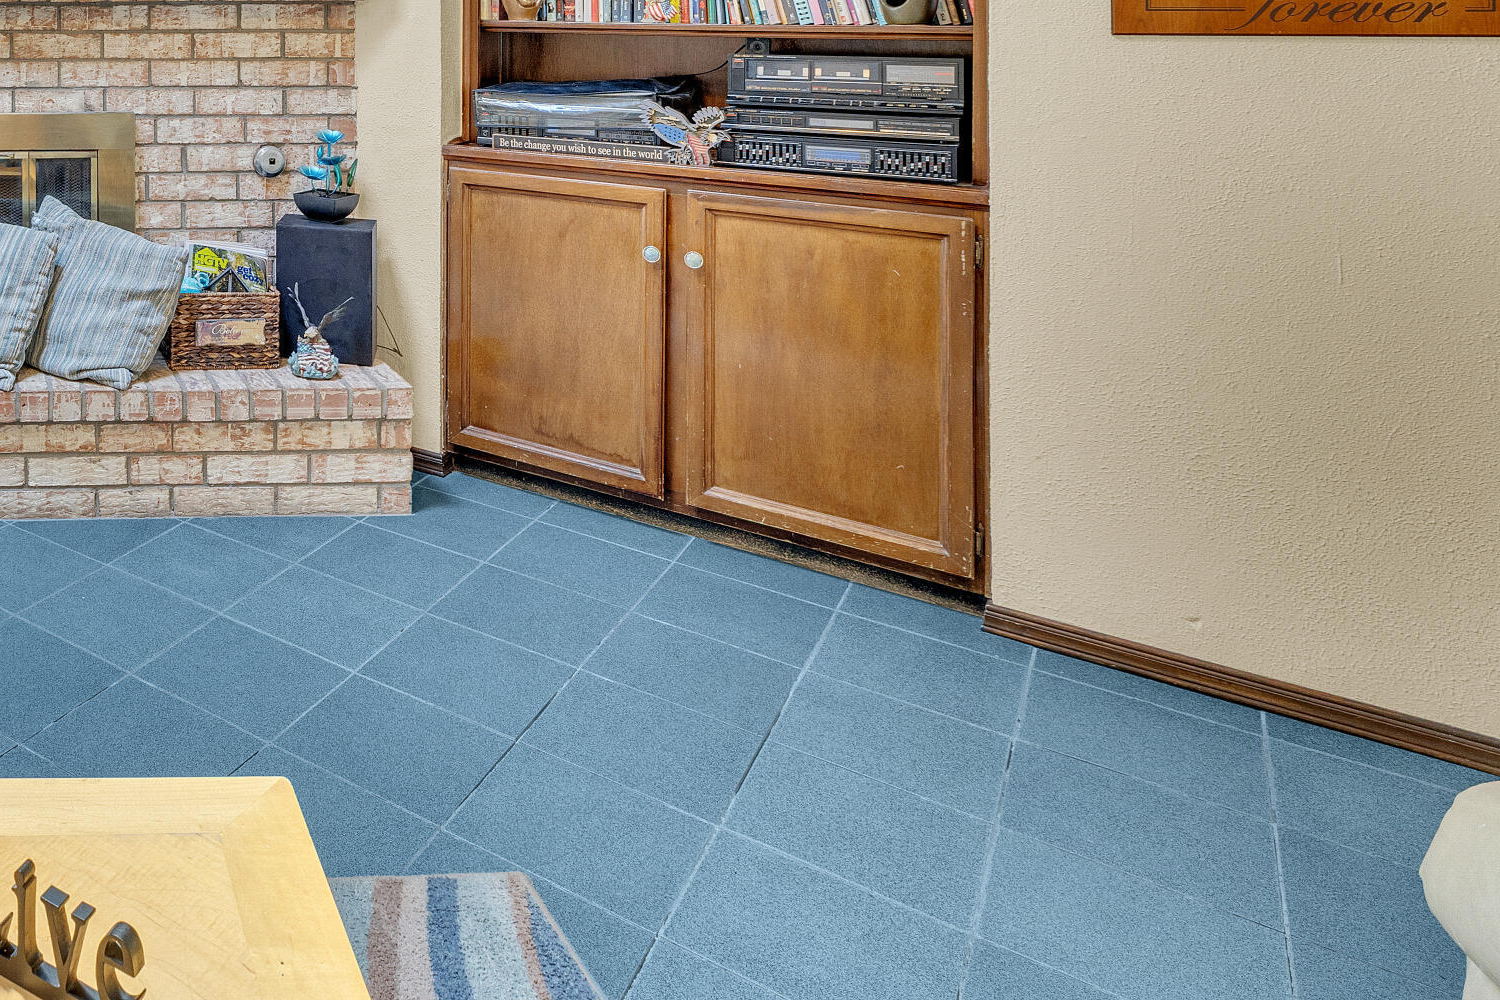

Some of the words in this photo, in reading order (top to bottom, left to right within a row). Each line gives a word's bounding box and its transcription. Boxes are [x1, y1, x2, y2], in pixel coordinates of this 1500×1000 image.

[499, 137, 509, 147] Be
[510, 138, 523, 149] the
[524, 139, 551, 152] change
[552, 143, 567, 154] you
[568, 143, 587, 154] wish
[588, 145, 597, 154] to
[598, 148, 612, 156] see
[613, 147, 621, 156] in
[622, 147, 637, 158] the
[637, 149, 663, 160] world
[194, 254, 229, 269] HGTV
[237, 265, 252, 275] get
[243, 274, 264, 286] cozy
